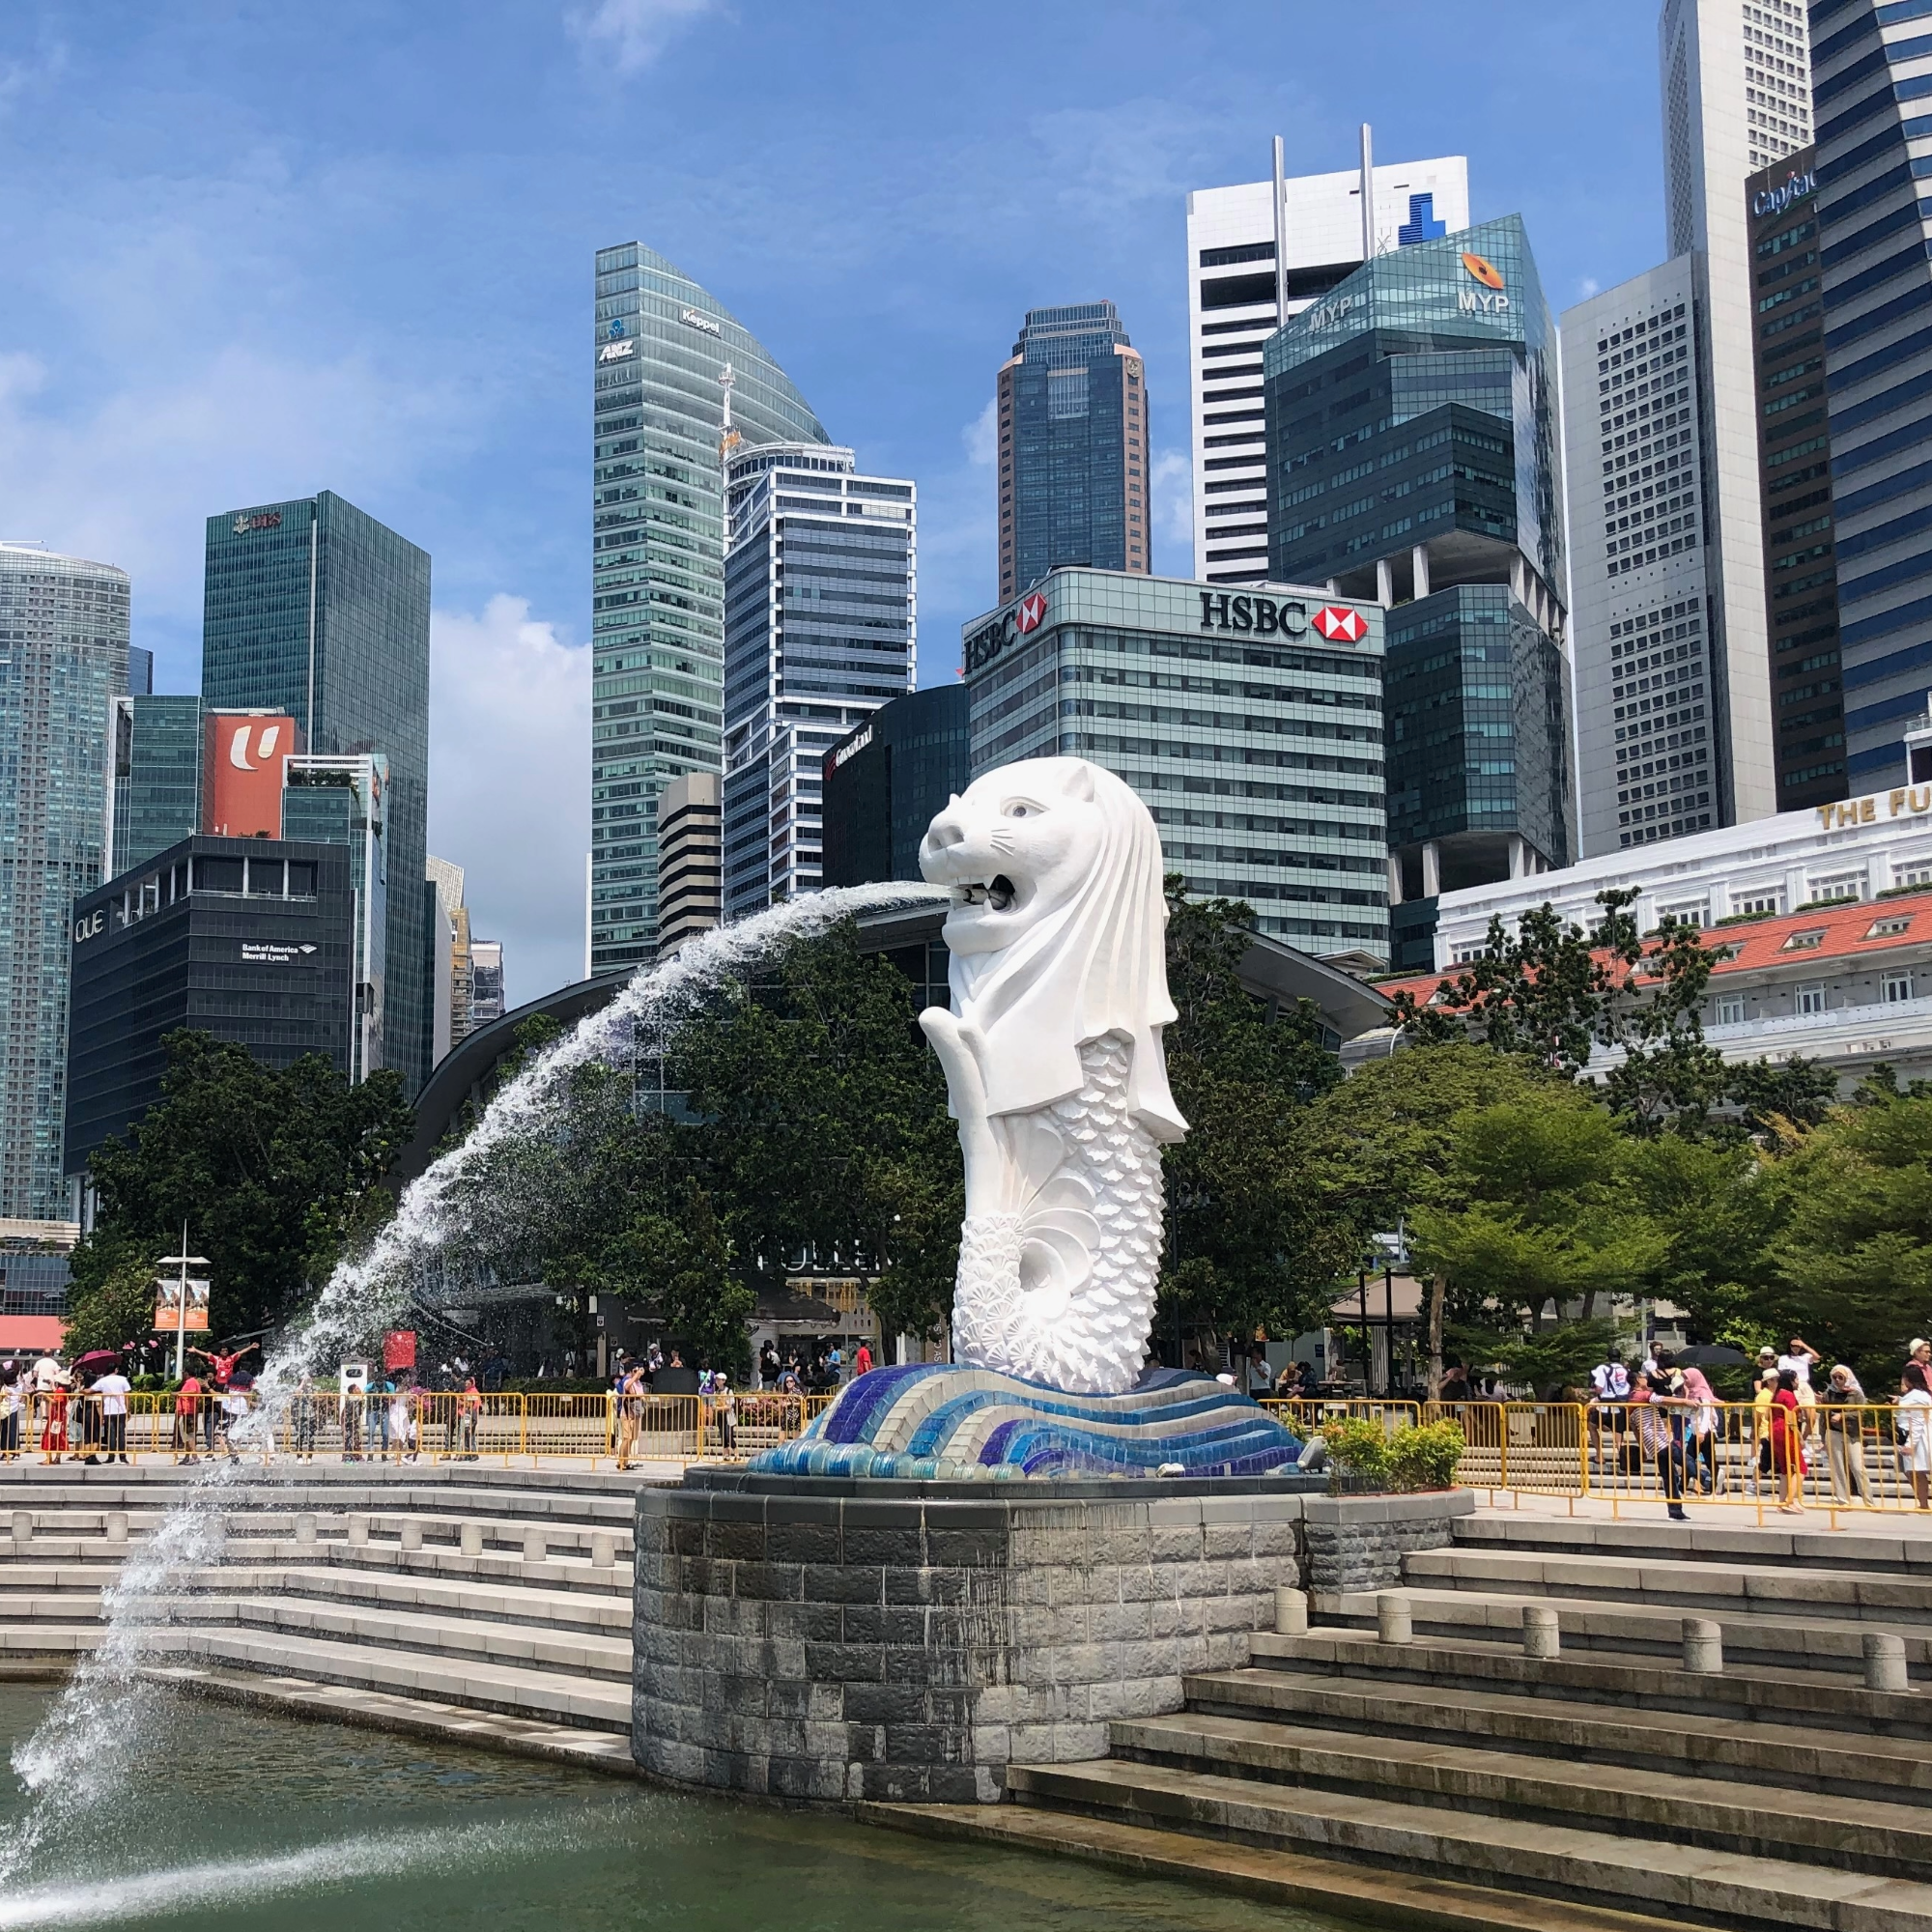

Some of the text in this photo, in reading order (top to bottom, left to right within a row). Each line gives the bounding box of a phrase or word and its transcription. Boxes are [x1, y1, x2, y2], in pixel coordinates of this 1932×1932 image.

[1309, 297, 1352, 331] MYP
[1458, 291, 1509, 313] MYP
[682, 309, 720, 334] Keppel
[599, 340, 634, 362] ANZ
[1200, 591, 1307, 636] HSBC
[964, 610, 1016, 675] HSBC
[1816, 787, 1931, 831] THE FU
[75, 909, 104, 943] OUE
[242, 943, 298, 954] Bank of America
[242, 952, 290, 962] Merrill Lynch
